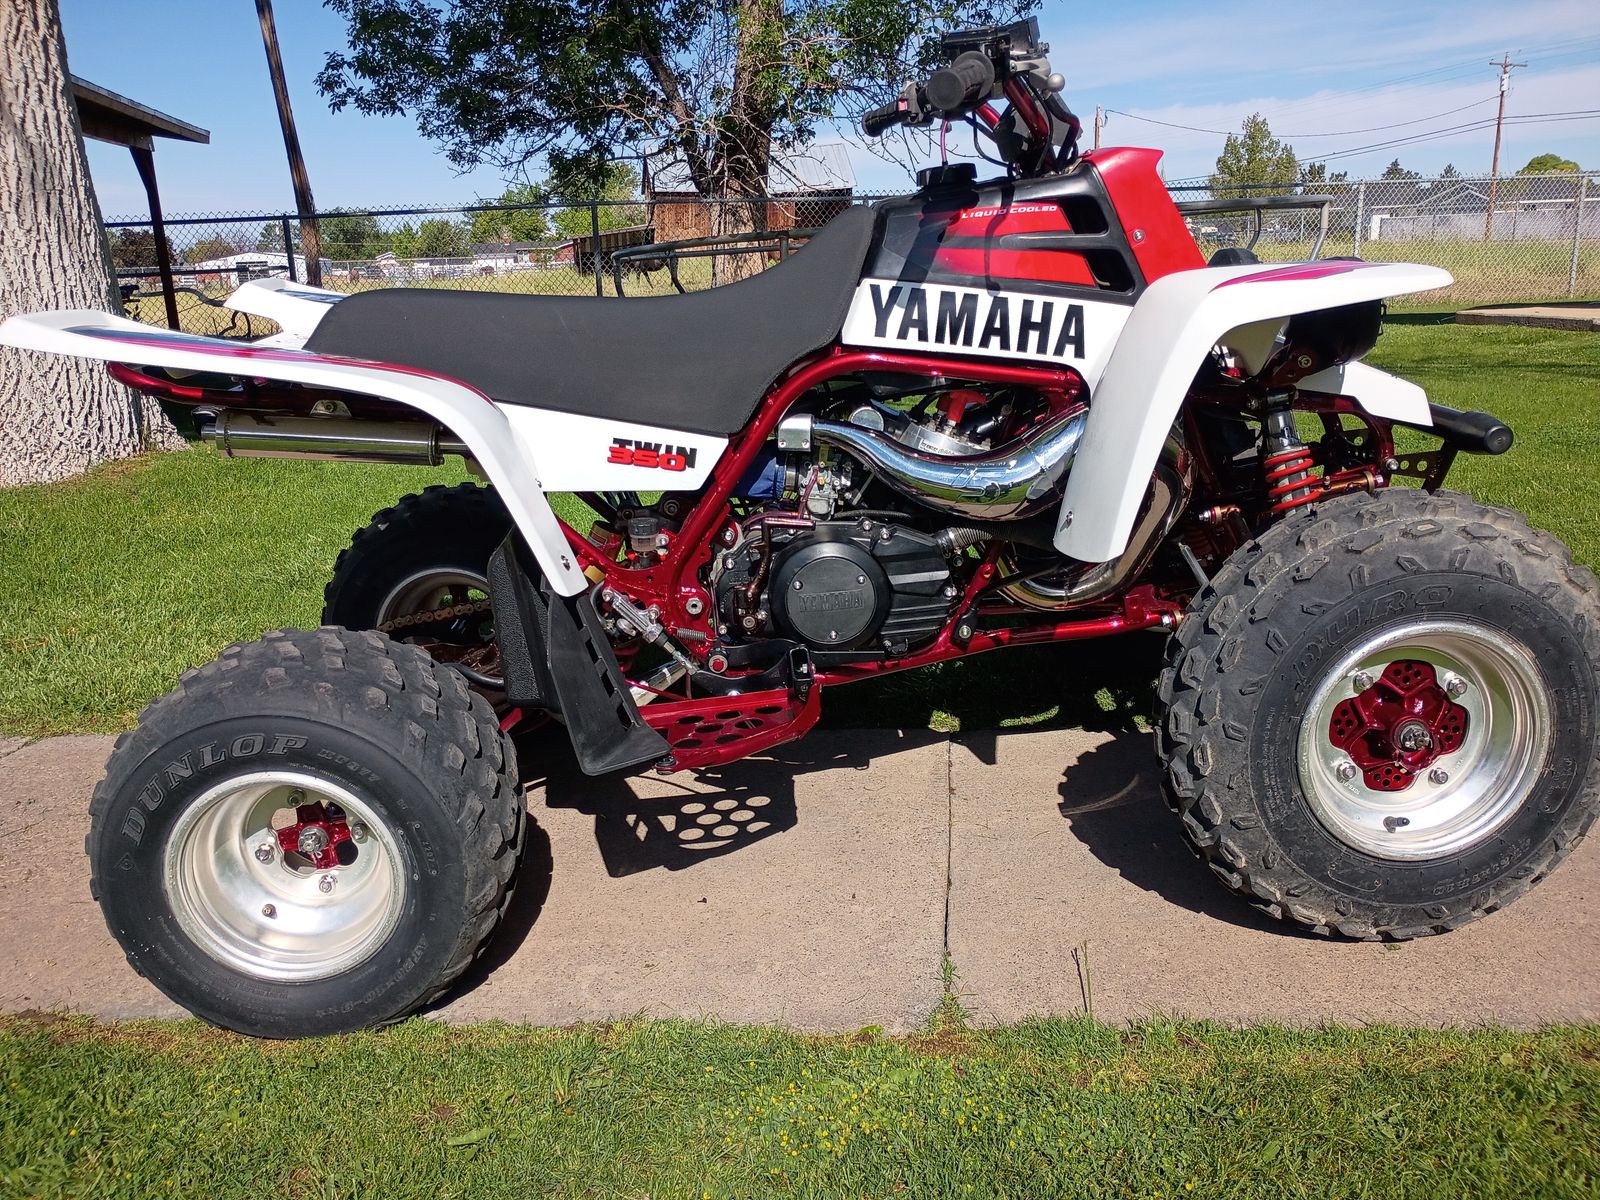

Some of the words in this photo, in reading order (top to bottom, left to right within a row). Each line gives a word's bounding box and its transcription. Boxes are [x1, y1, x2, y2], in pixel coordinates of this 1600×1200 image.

[962, 208, 1007, 219] LIQUID
[1010, 205, 1058, 214] COOLED
[869, 283, 1086, 360] YAMAHA
[607, 445, 687, 472] 350
[121, 733, 309, 847] DUNLOP
